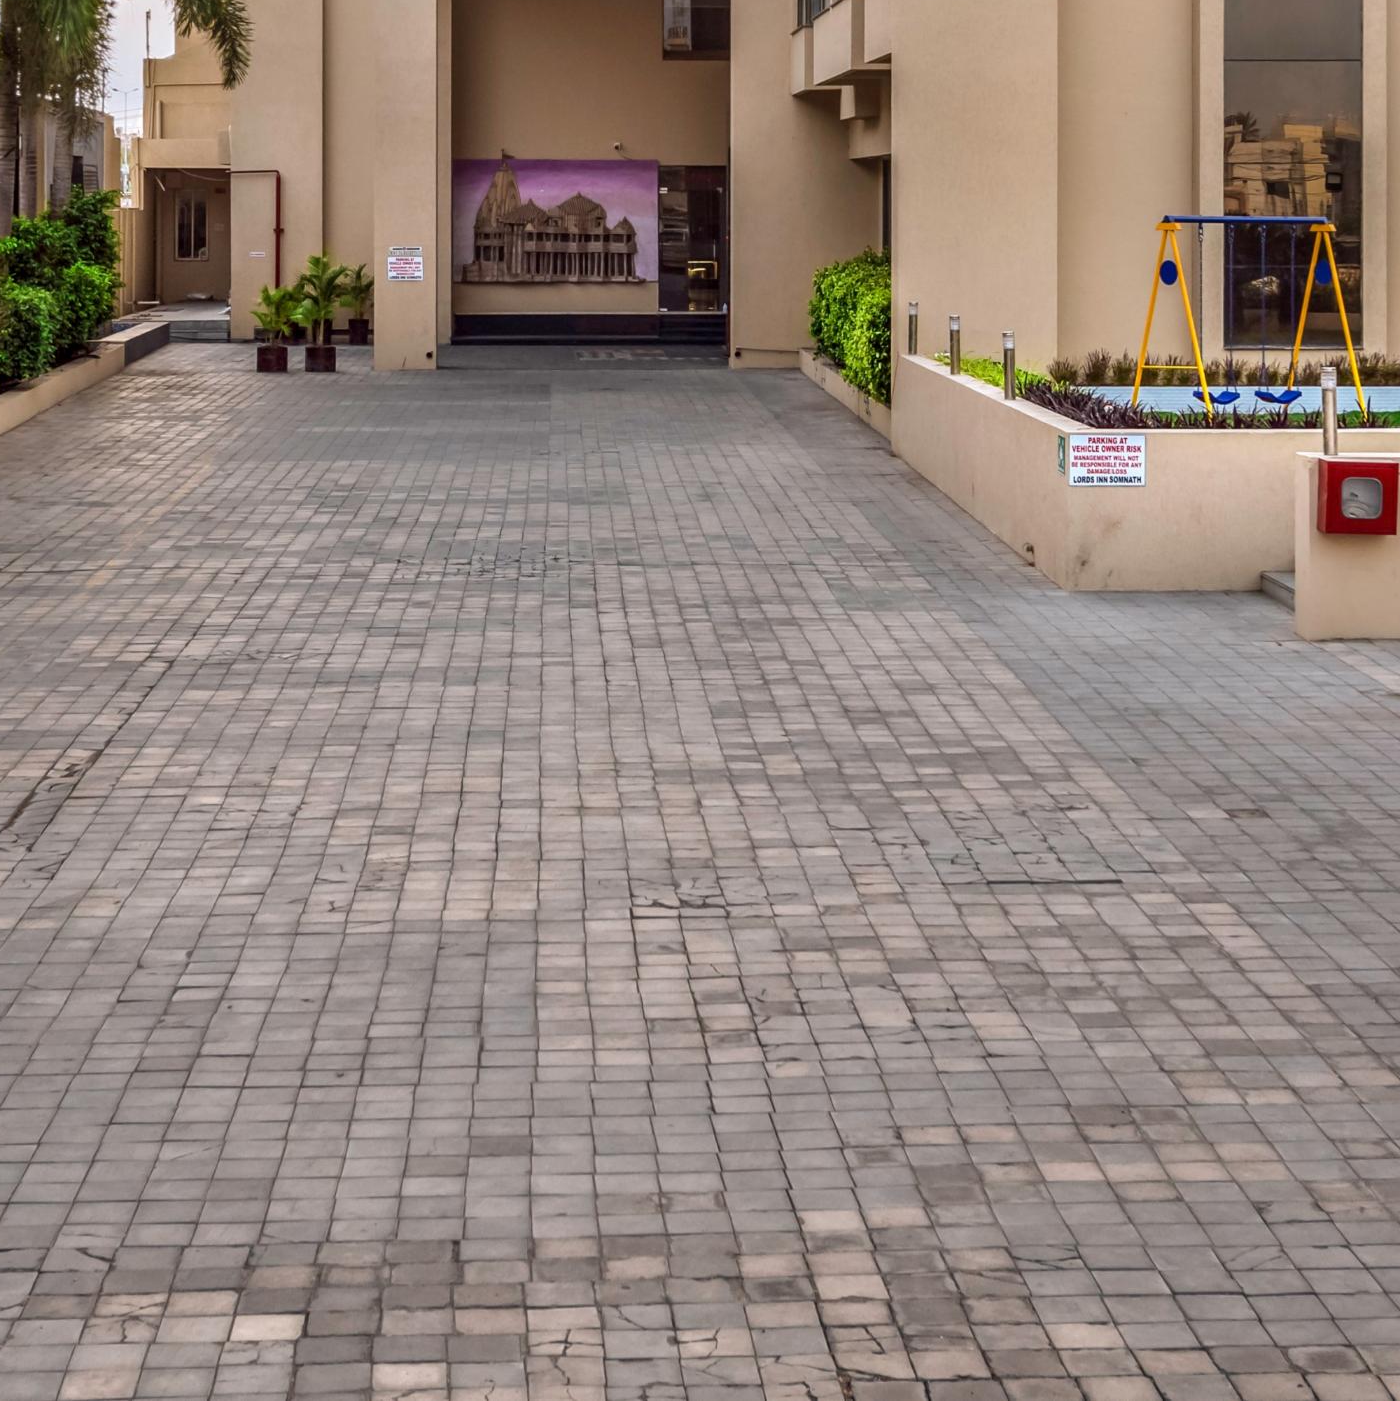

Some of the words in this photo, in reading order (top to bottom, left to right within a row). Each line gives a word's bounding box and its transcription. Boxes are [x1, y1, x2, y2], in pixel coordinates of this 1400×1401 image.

[1072, 445, 1099, 453] VEHICLE
[1101, 445, 1125, 453] OWNER
[1126, 445, 1142, 453] RISK
